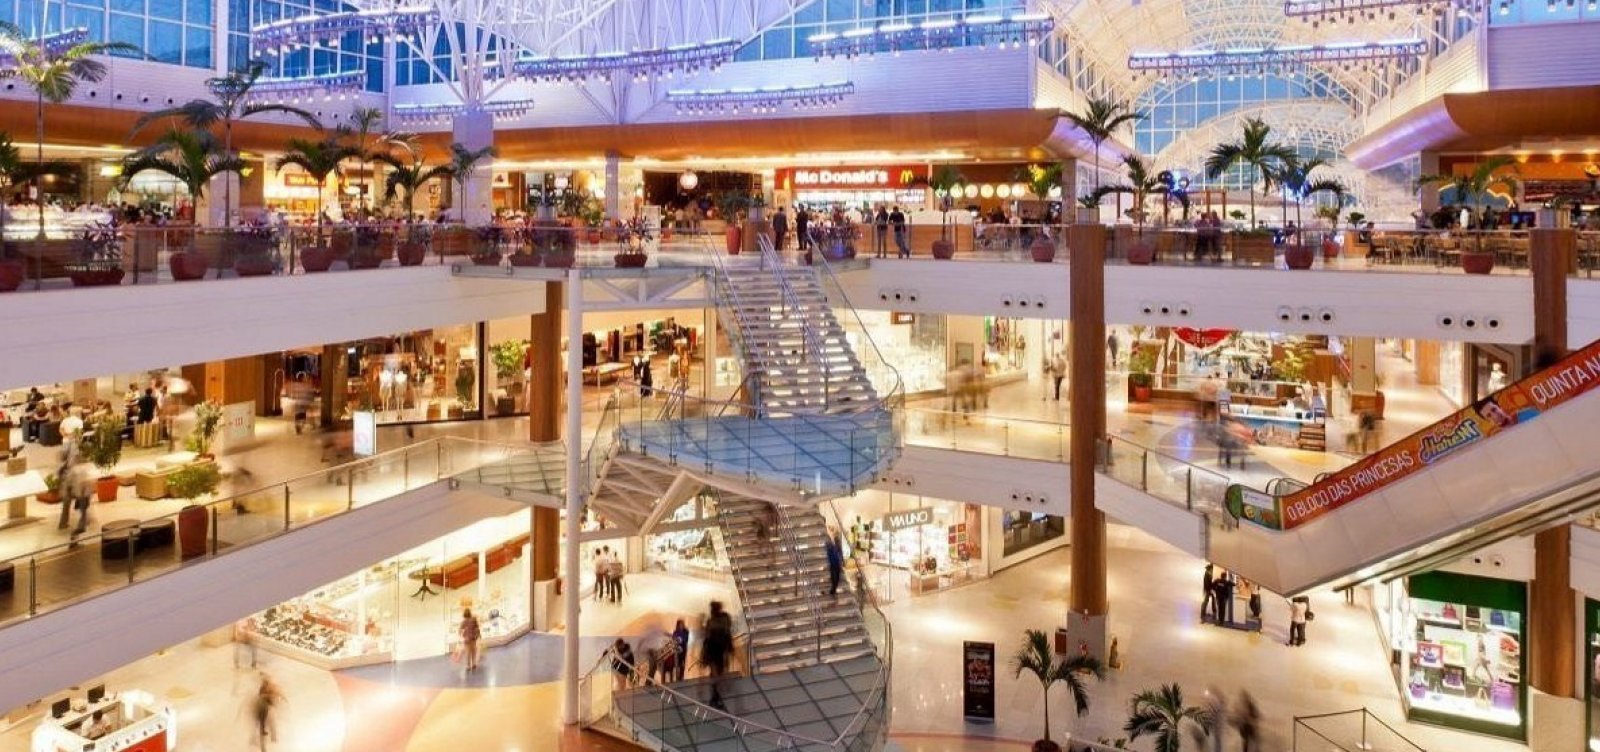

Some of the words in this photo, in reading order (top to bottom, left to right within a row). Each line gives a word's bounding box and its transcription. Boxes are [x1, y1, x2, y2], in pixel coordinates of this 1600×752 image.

[1531, 364, 1591, 405] QUINTA
[1286, 505, 1297, 521] O
[1296, 488, 1330, 518] BLOCO
[1329, 480, 1353, 502] DAS
[1350, 450, 1415, 491] PRINCESAS
